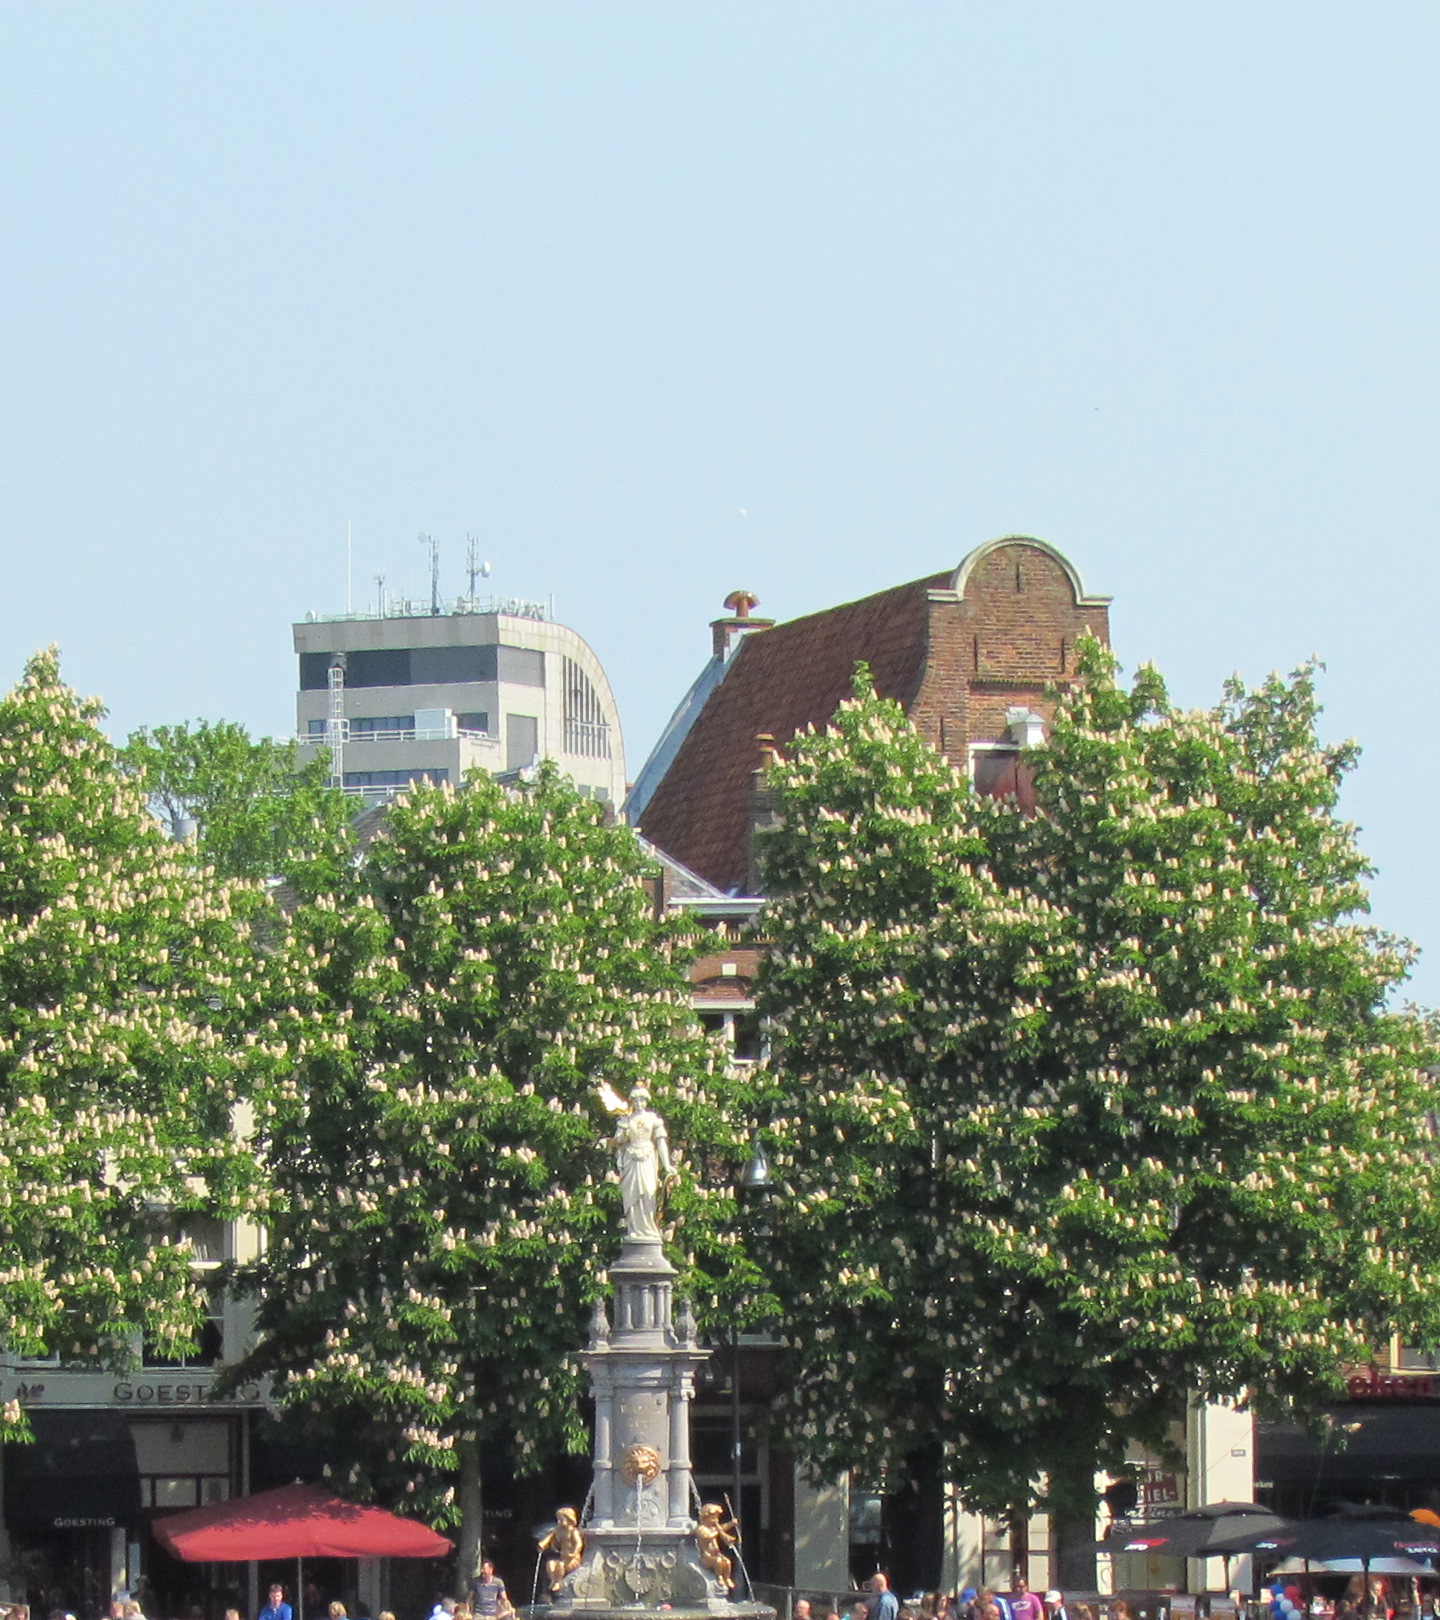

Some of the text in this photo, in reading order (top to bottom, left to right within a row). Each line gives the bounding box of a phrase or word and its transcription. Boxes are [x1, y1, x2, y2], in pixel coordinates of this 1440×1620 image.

[113, 1382, 260, 1401] GOESTG
[483, 1509, 513, 1519] TING
[54, 1516, 116, 1528] GOESTING
